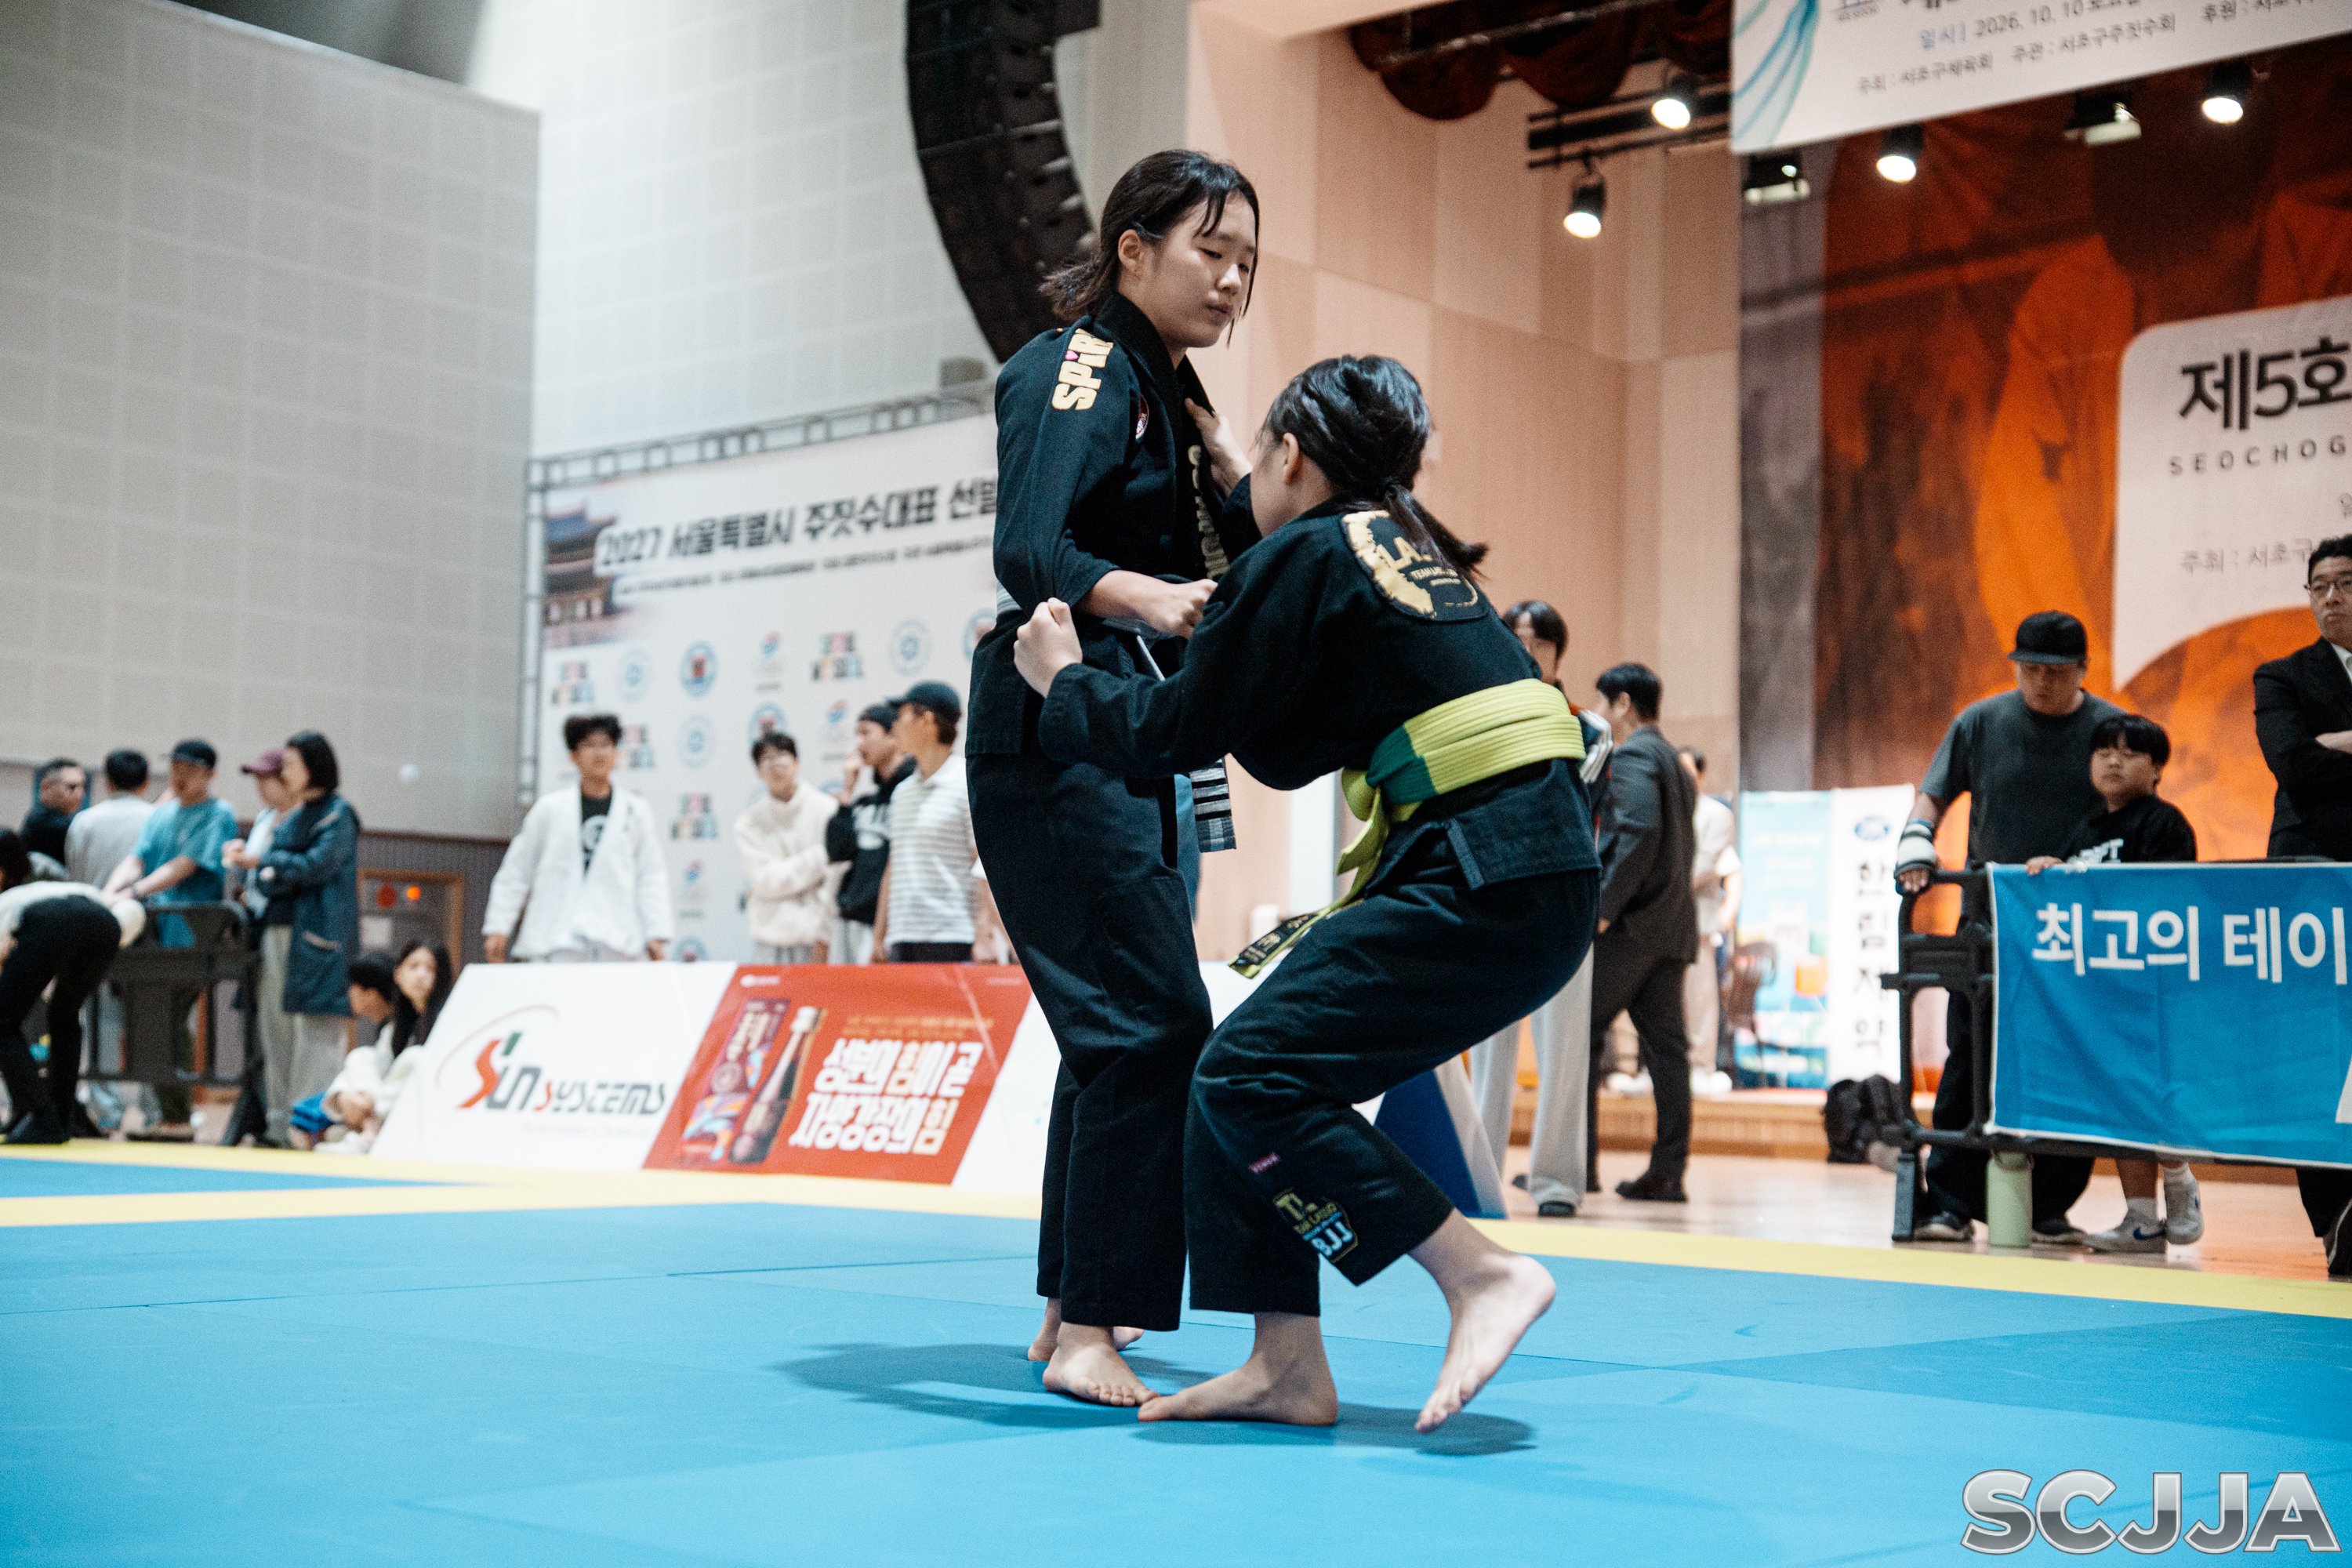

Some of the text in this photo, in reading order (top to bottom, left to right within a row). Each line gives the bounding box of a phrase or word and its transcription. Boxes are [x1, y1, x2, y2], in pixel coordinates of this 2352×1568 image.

[668, 506, 796, 557] 서울특별시
[804, 485, 939, 542] 주짓수대표
[2032, 902, 2200, 982] 최고의
